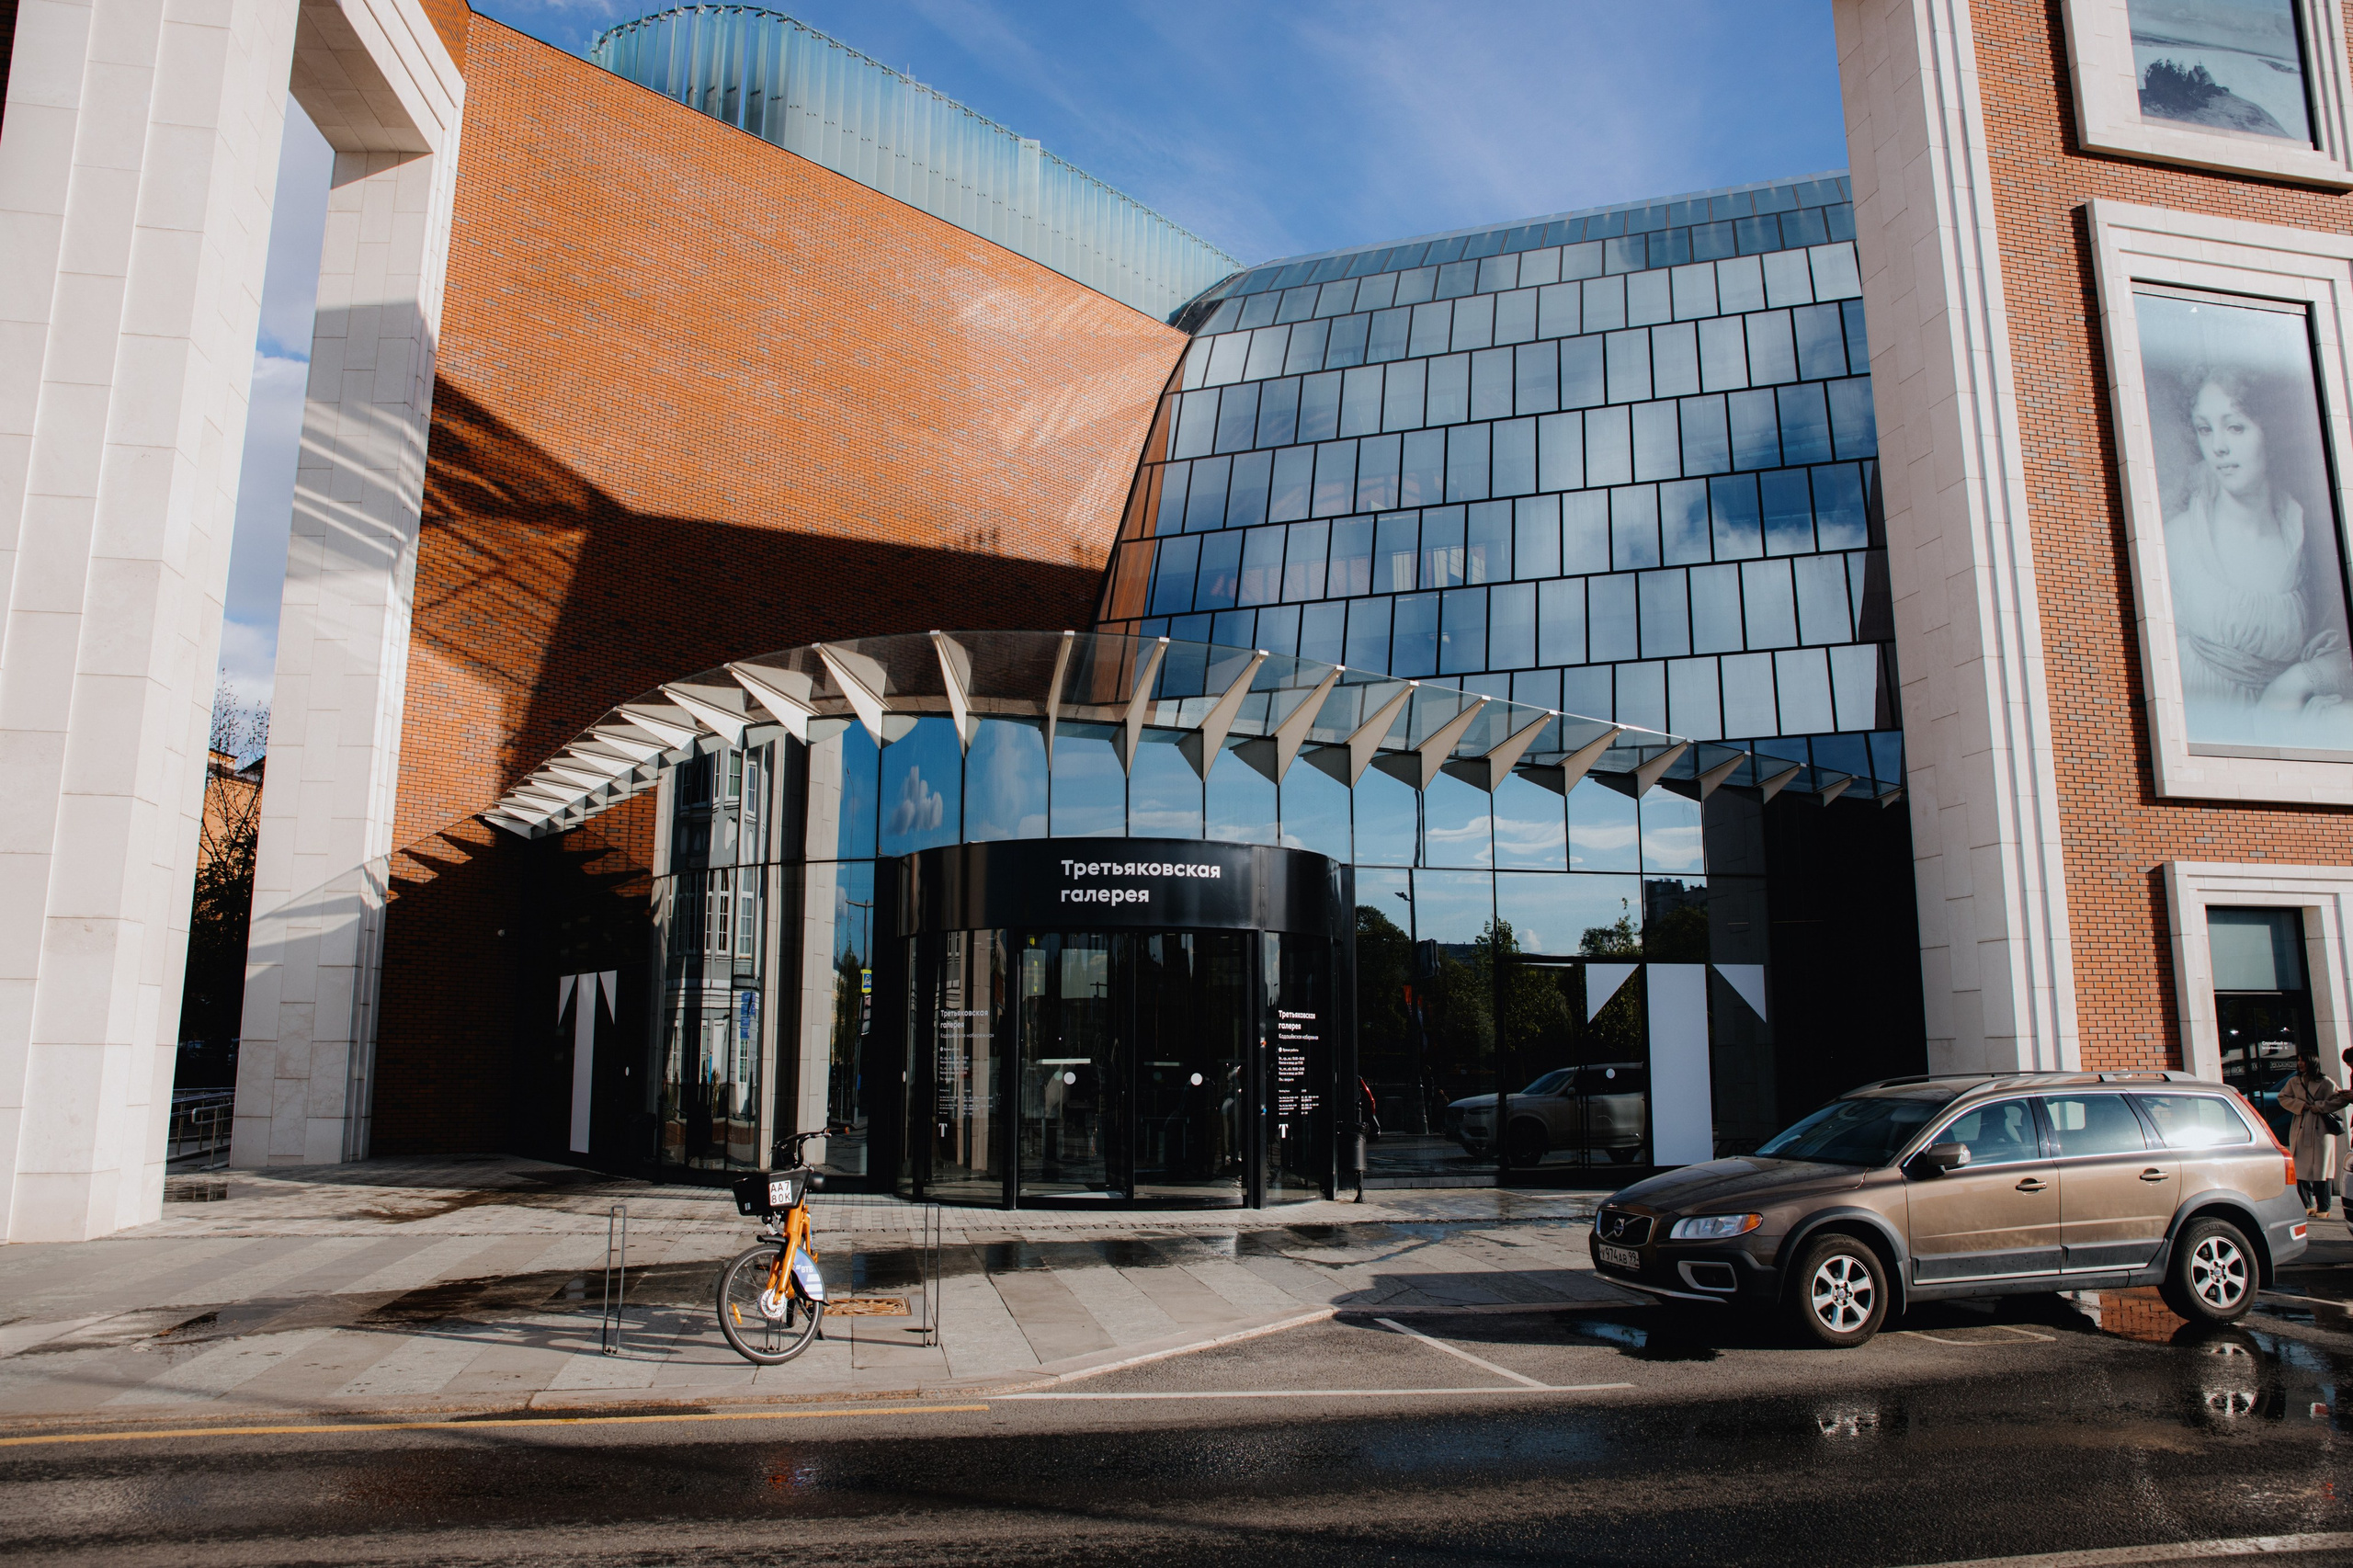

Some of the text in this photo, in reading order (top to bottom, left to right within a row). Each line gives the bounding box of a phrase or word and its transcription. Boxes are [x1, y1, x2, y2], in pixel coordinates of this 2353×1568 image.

[1061, 859, 1221, 880] Третьяковская
[1061, 889, 1149, 907] галерея
[940, 1009, 989, 1019] Третьяковская
[1279, 1010, 1315, 1019] Третьяковская
[1279, 1023, 1301, 1031] галерея
[801, 1265, 814, 1274] ВТБ
